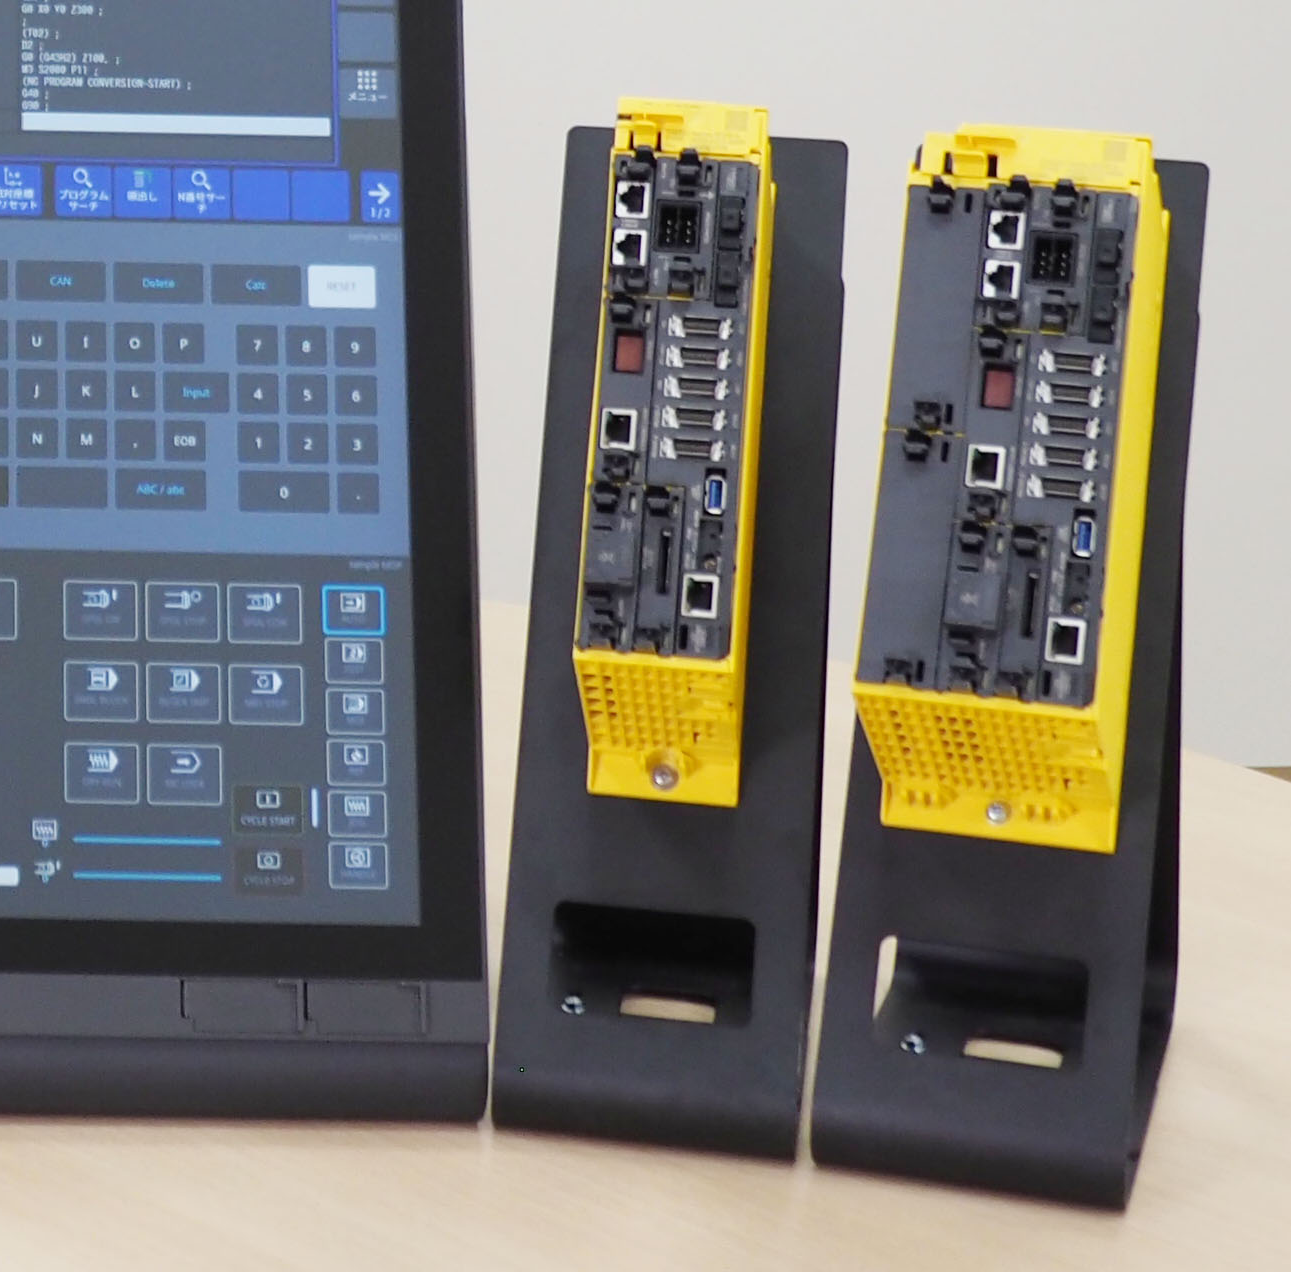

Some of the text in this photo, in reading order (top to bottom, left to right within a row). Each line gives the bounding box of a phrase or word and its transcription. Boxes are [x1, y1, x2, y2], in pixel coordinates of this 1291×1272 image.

[44, 77, 83, 88] PROGRAM
[348, 91, 387, 102] メニュー
[60, 189, 109, 202] プログラム
[371, 207, 390, 219] 1/2
[50, 276, 72, 286] CAN
[142, 278, 175, 288] Delete
[32, 336, 42, 347] U
[129, 337, 140, 349] O
[180, 338, 188, 350] P
[254, 339, 261, 351] 7
[302, 341, 311, 353] 8
[351, 342, 359, 353] 9
[34, 385, 39, 398] J
[82, 386, 90, 397] K
[132, 387, 139, 398] L
[183, 387, 210, 399] Input
[254, 388, 263, 400] 4
[303, 389, 312, 401] 5
[352, 390, 361, 402] 6
[32, 433, 43, 444] N
[81, 434, 93, 446] M
[256, 437, 261, 448] 1
[304, 438, 312, 450] 2
[353, 439, 362, 451] 3
[280, 487, 289, 499] 0
